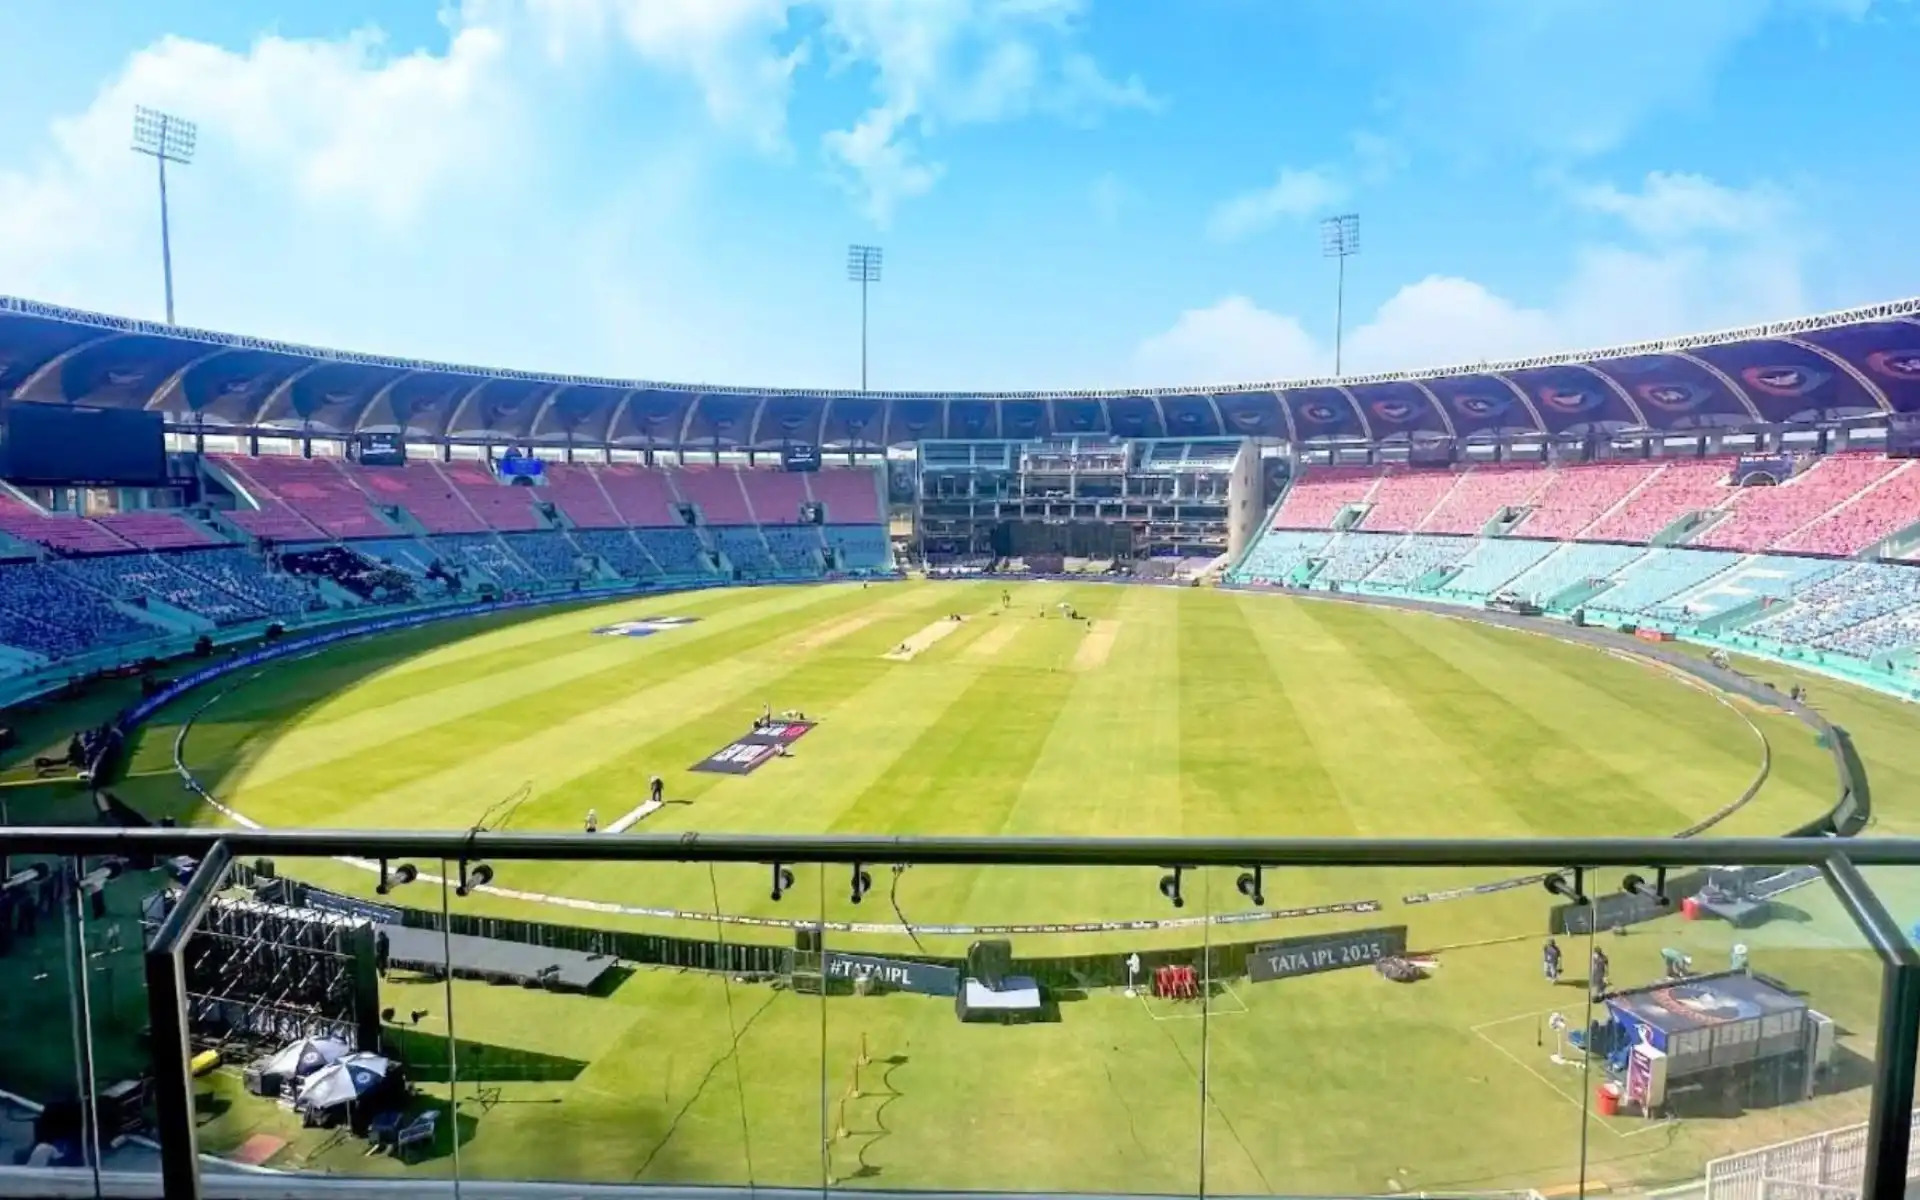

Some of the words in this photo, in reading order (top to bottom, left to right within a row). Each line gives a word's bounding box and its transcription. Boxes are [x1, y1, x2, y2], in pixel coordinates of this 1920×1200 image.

[830, 958, 912, 985] #TATAIPL
[1268, 953, 1309, 973] TATA
[1312, 948, 1338, 966] IPL
[1341, 943, 1381, 962] 2025
